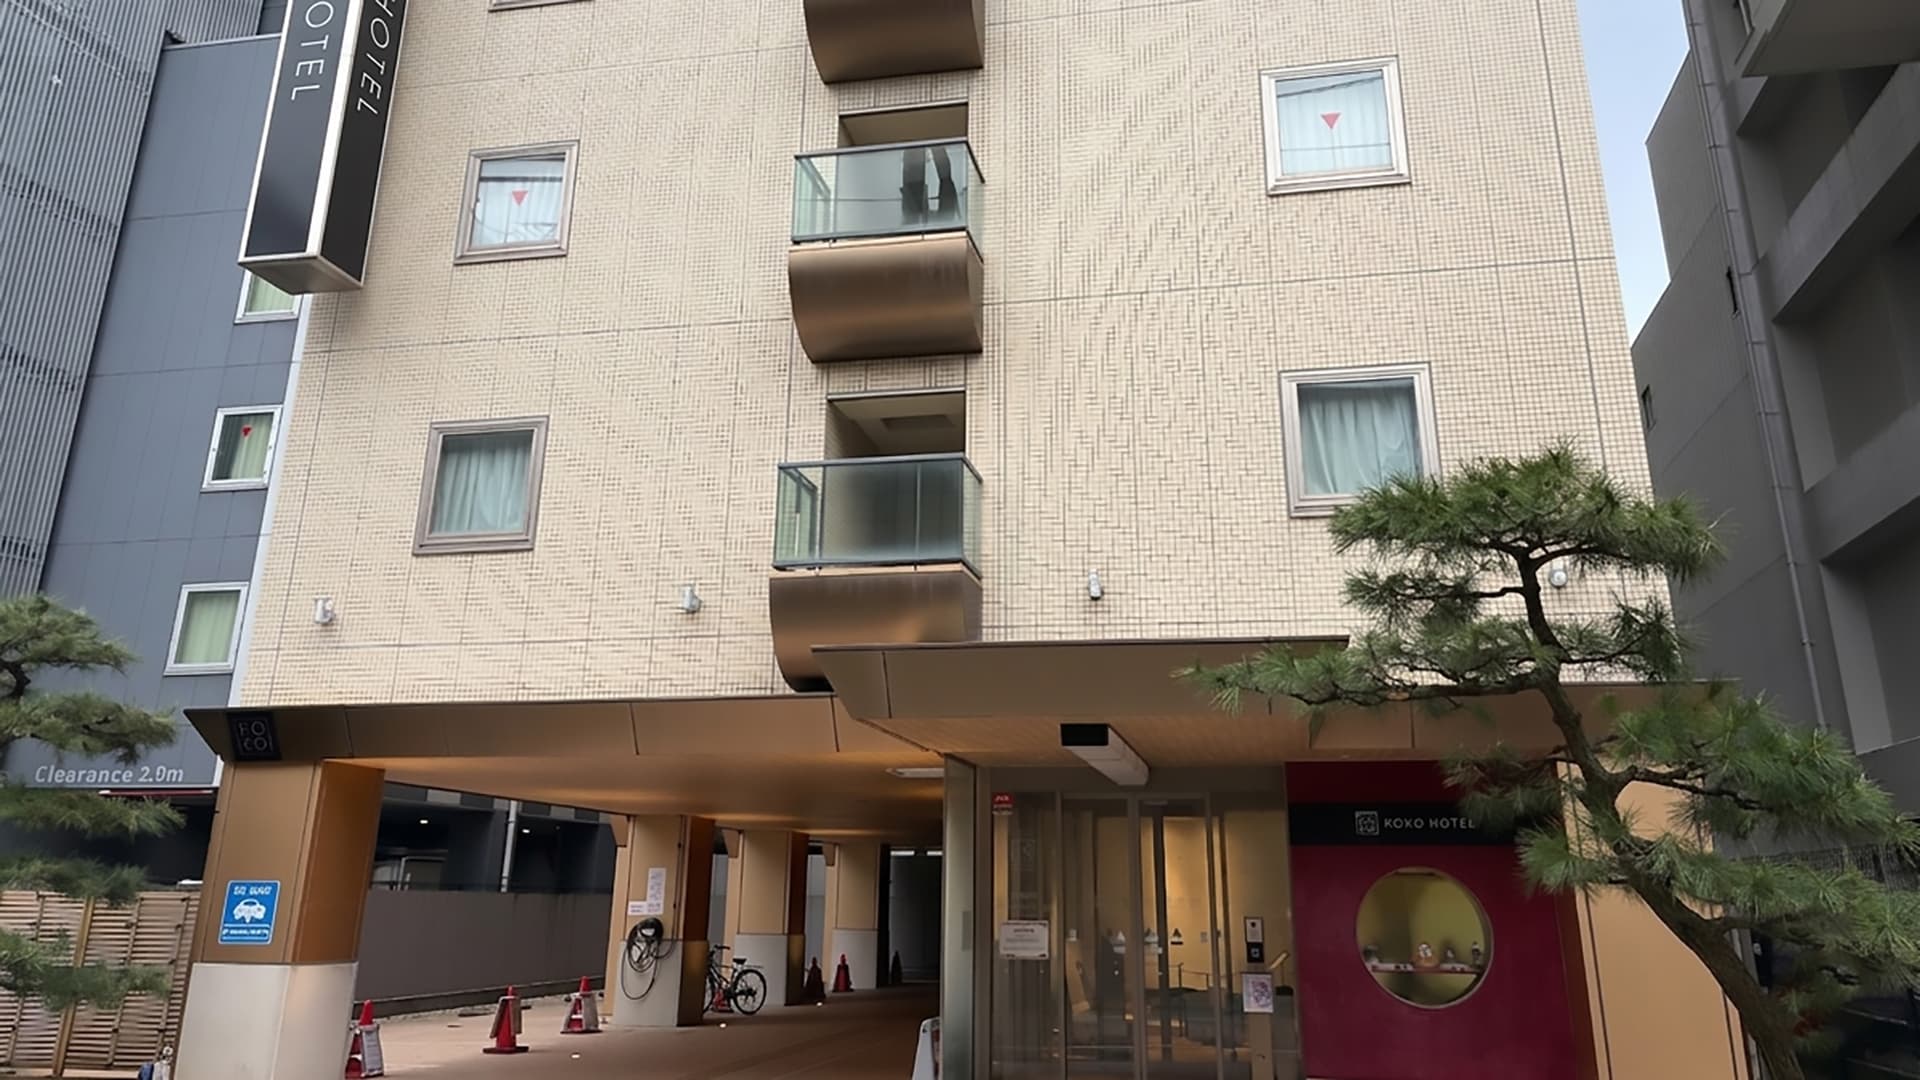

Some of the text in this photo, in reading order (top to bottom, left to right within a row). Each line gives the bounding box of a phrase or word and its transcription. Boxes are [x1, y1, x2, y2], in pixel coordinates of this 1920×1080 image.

[34, 764, 184, 783] Clearance 2.0m
[1429, 817, 1476, 829] HOTEL
